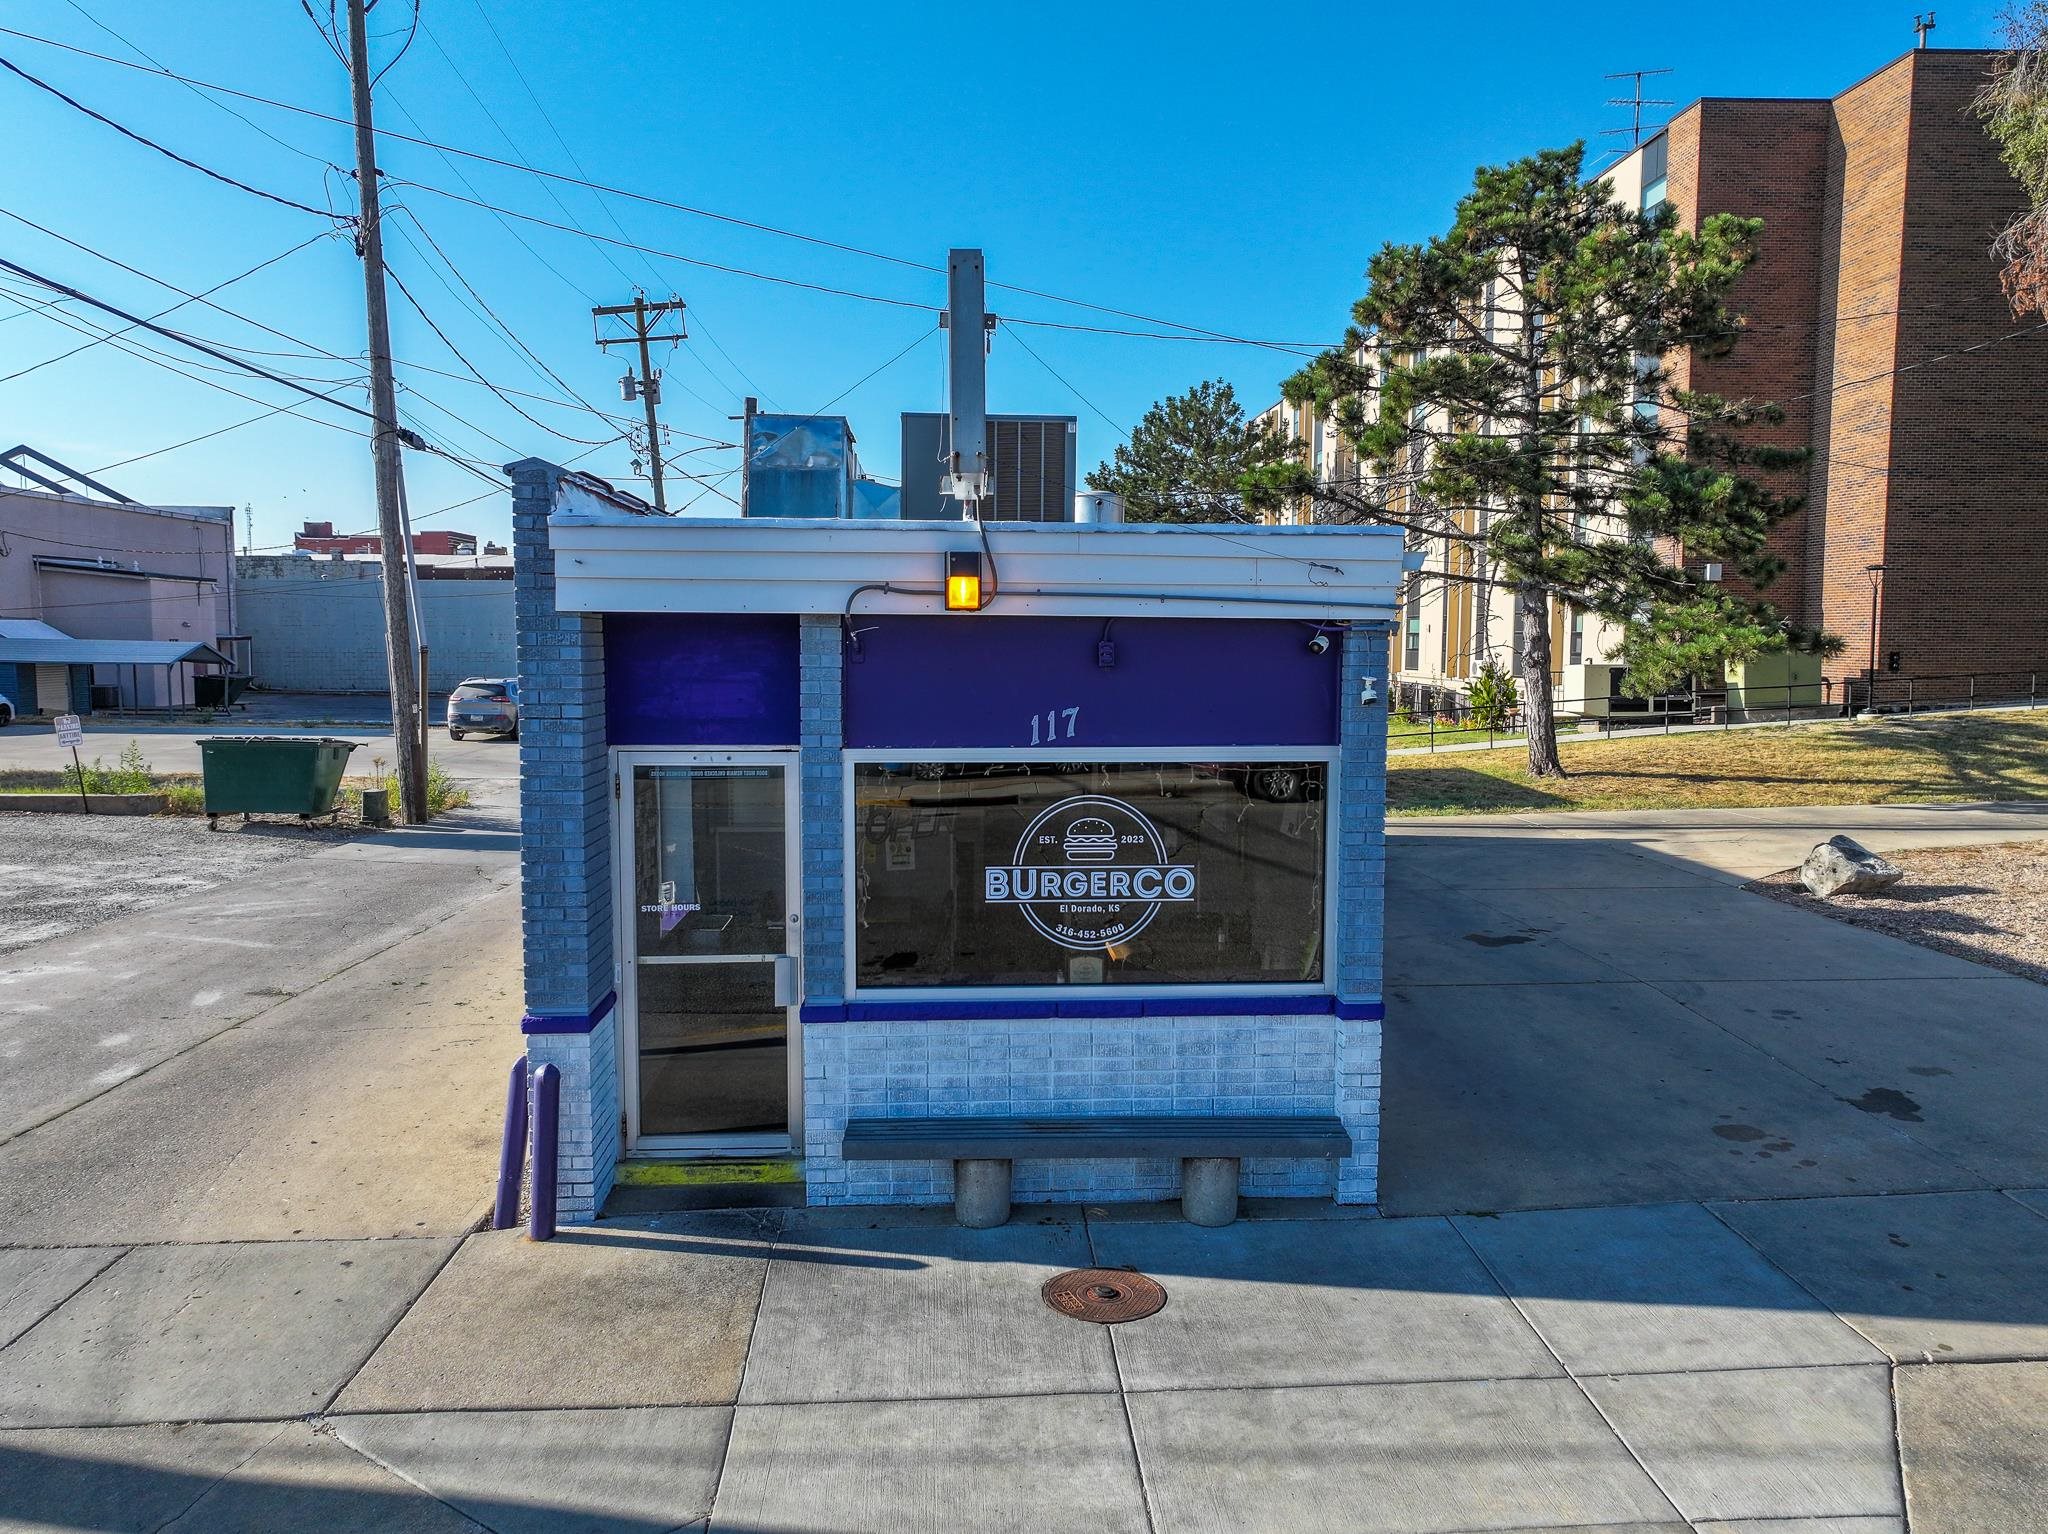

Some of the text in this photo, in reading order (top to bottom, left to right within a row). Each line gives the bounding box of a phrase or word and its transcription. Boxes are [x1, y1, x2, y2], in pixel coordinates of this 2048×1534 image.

[1030, 706, 1080, 746] 117
[1039, 835, 1058, 844] EST.
[1120, 835, 1145, 844] 2023
[985, 868, 1195, 899] BURGERCO
[671, 903, 701, 911] HOURS
[1059, 904, 1121, 914] El Dorado, KS
[1055, 922, 1125, 939] 316-452-5600
